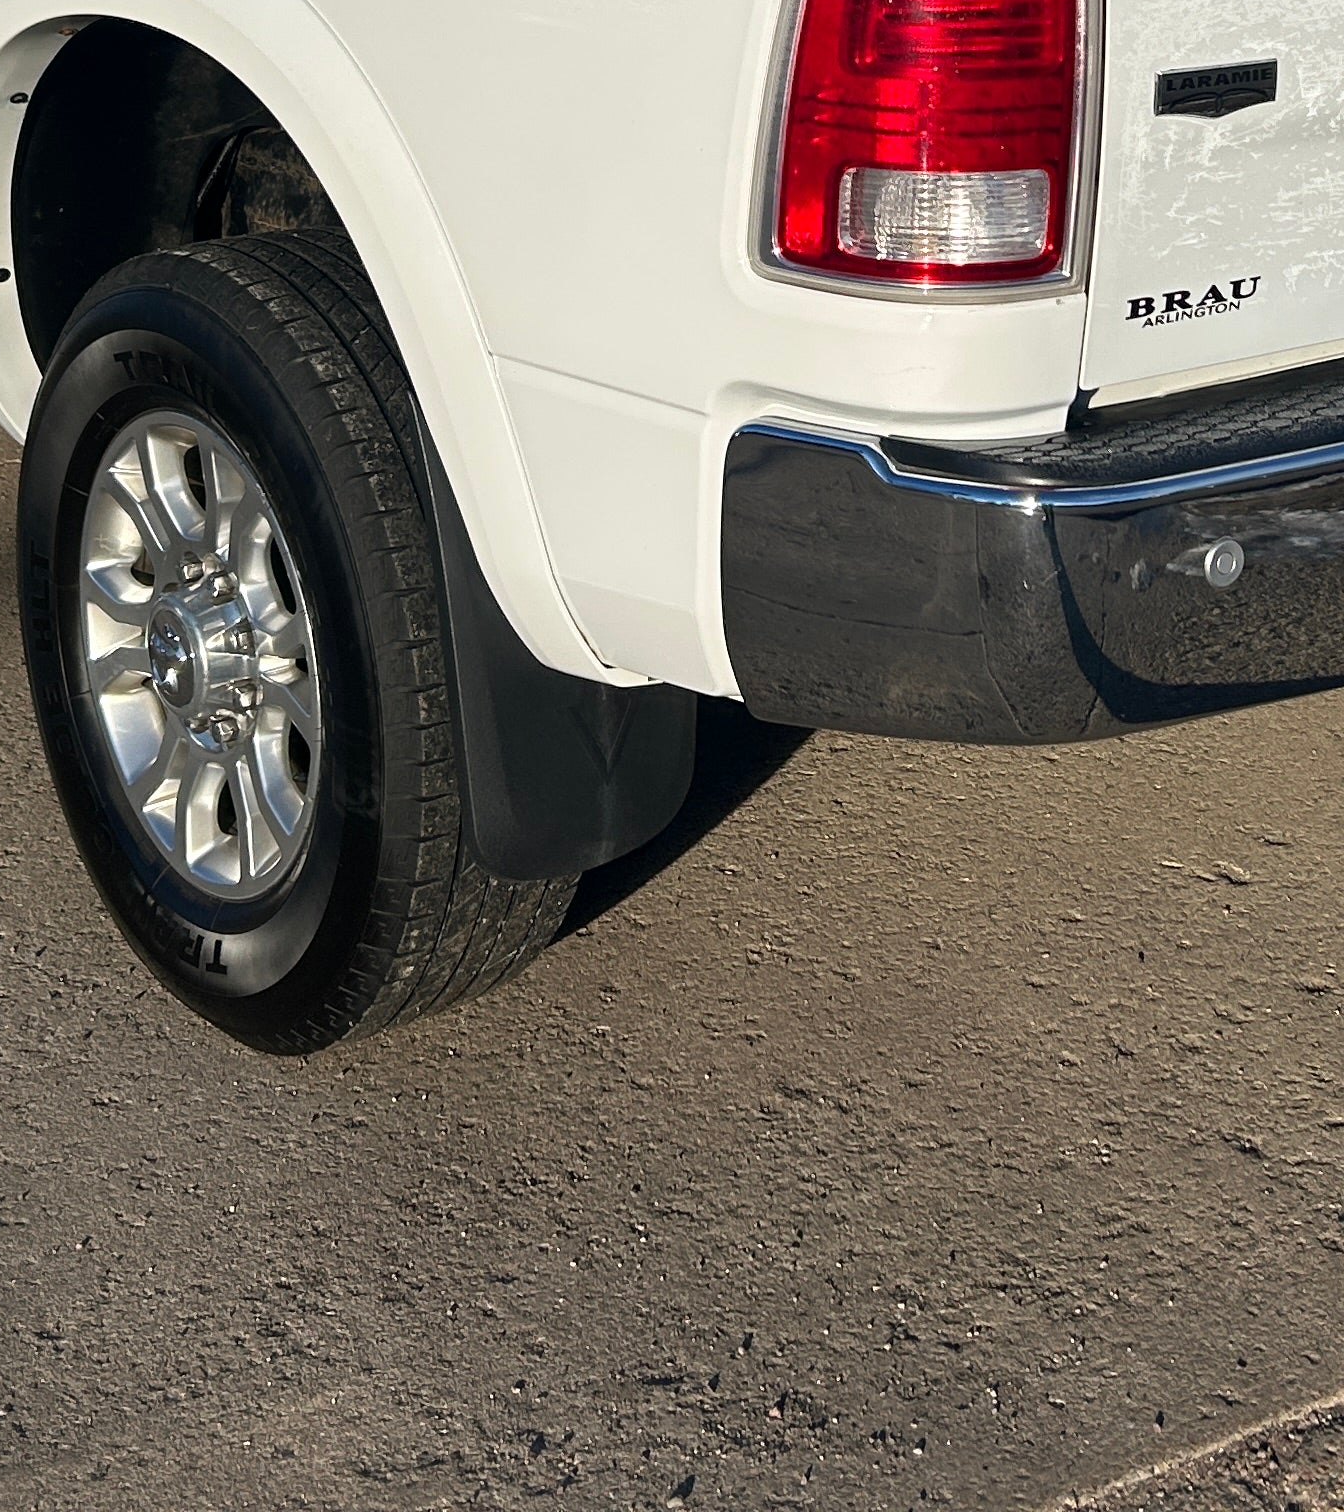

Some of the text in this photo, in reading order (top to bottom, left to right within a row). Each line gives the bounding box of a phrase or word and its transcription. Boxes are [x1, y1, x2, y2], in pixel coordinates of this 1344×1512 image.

[1166, 68, 1273, 92] LARAMIE
[1125, 276, 1261, 321] BRAU
[1142, 300, 1241, 328] ARLINGTON
